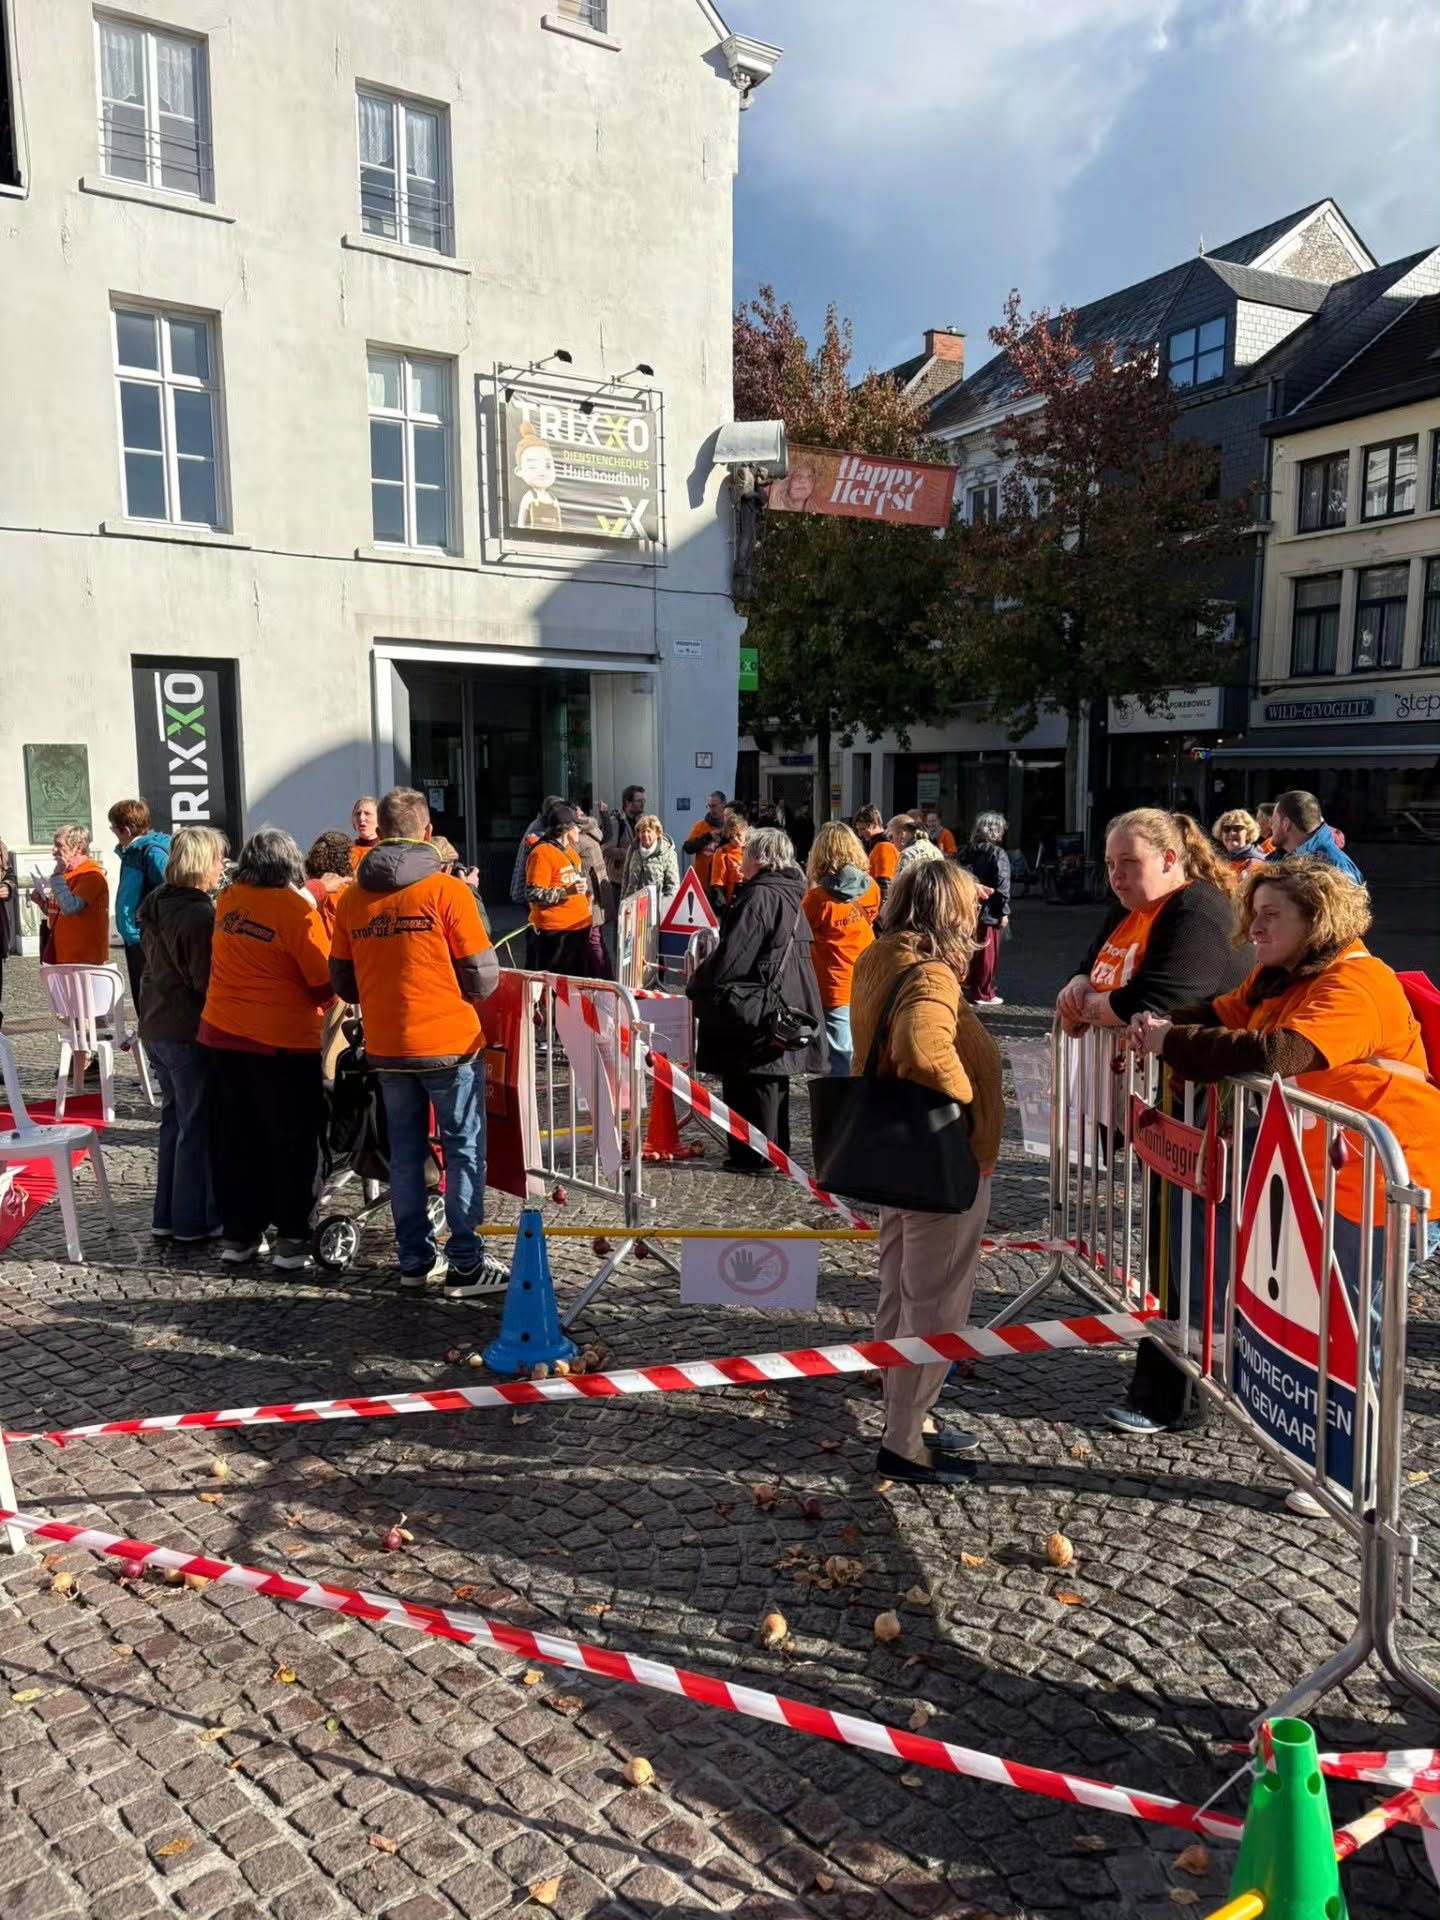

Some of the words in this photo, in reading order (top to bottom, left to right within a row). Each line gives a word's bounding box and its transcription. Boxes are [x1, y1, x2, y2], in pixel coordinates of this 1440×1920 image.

[512, 399, 650, 453] TRIXXO
[562, 450, 650, 471] DIENSTENCHEQUES
[563, 464, 650, 490] Huishoudhulp
[836, 455, 922, 492] Happy
[829, 478, 919, 516] Herfst
[1268, 700, 1370, 719] WILD-GEVOGELTE
[1240, 1369, 1251, 1399] IN
[1251, 1385, 1317, 1453] GEVAAR
